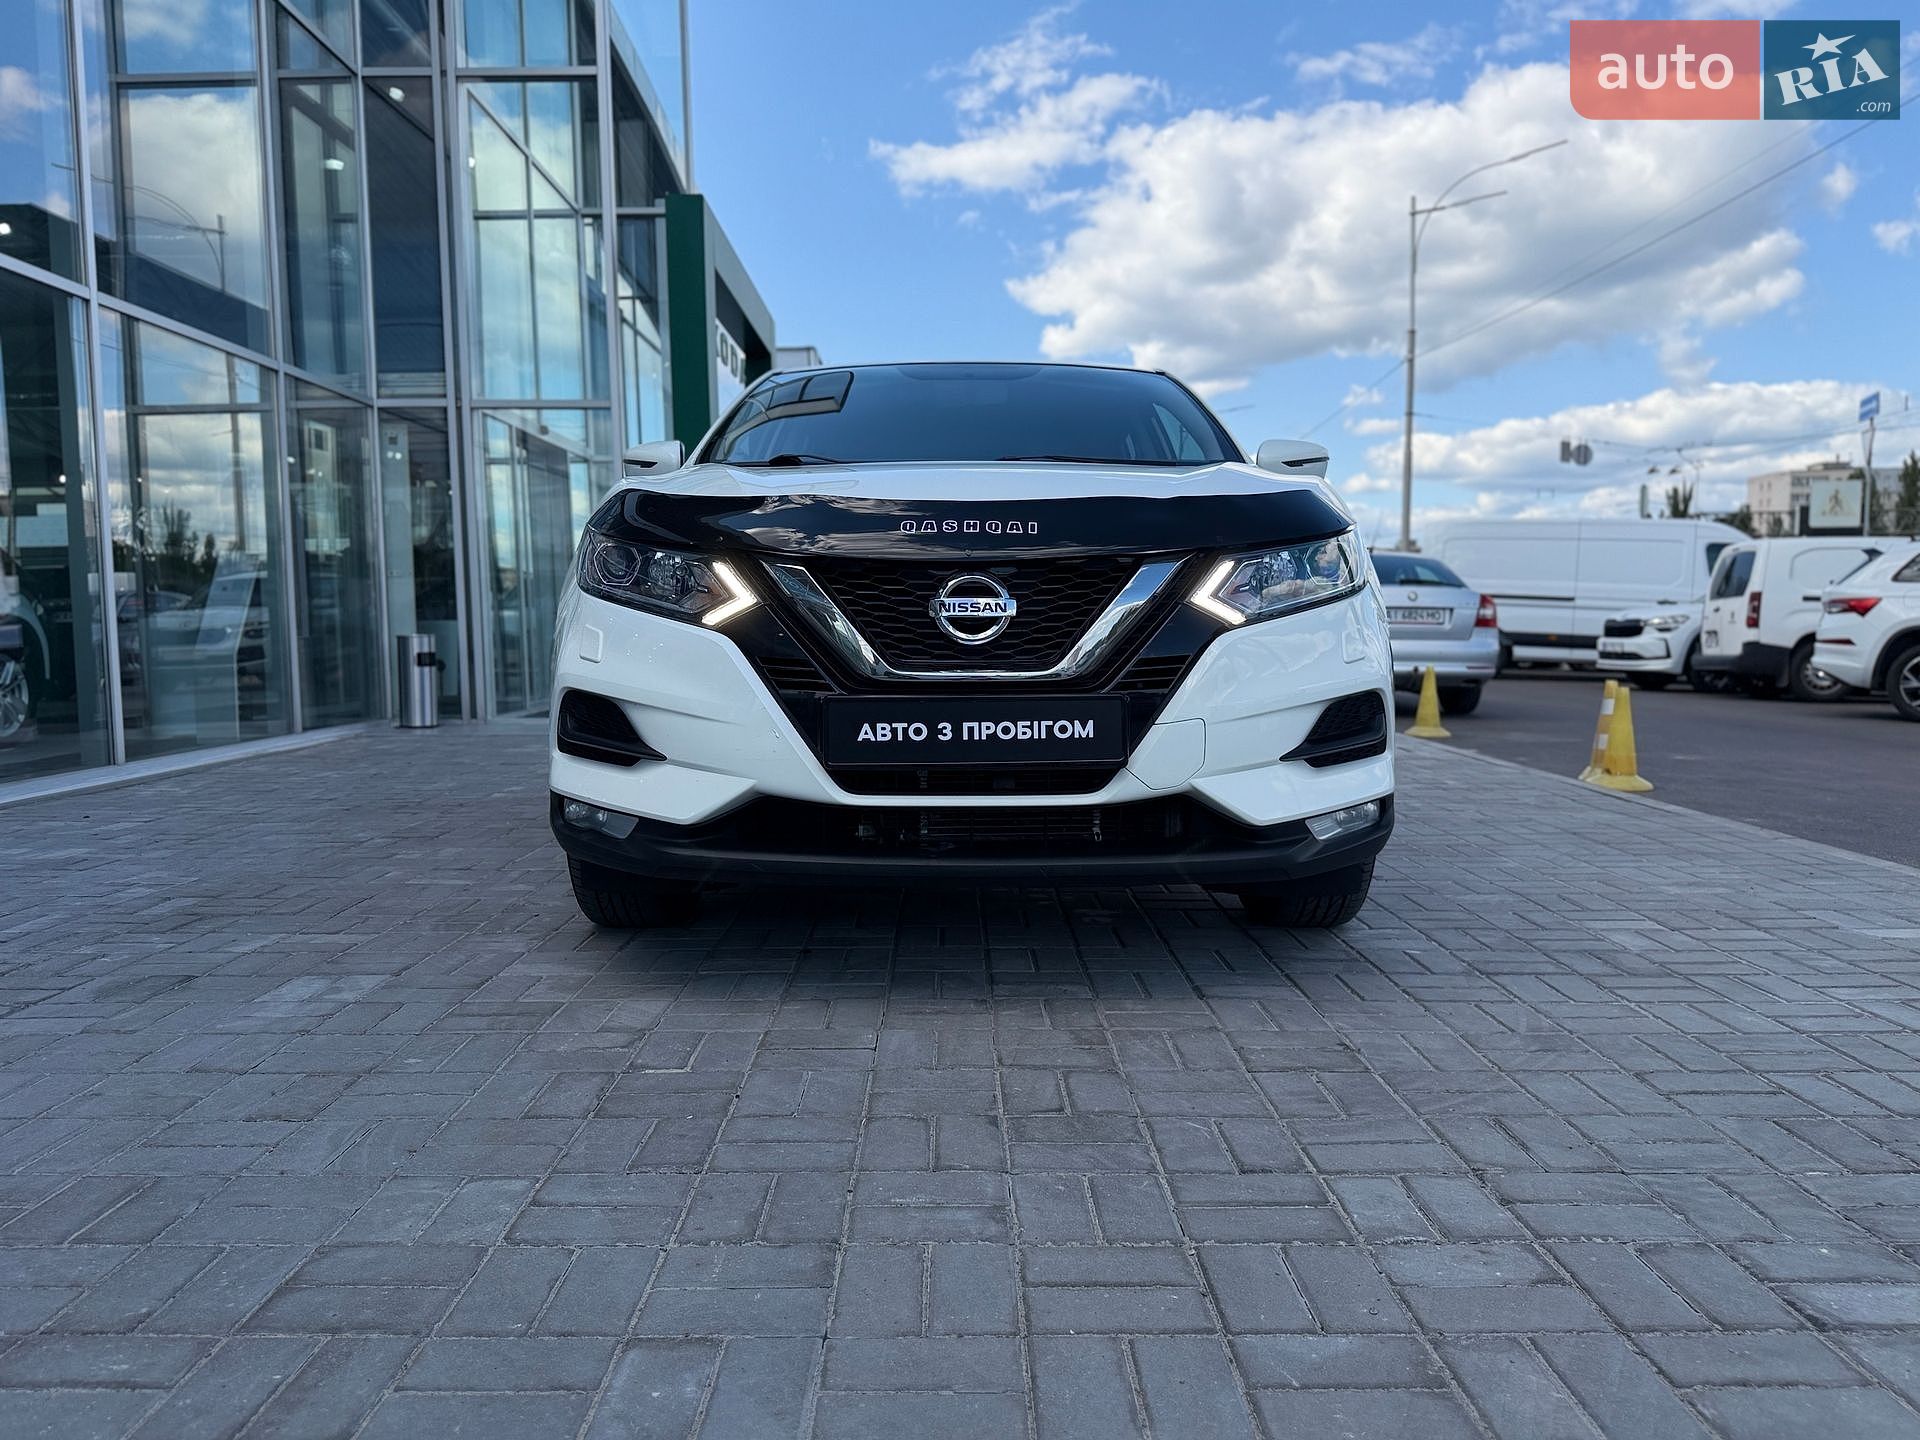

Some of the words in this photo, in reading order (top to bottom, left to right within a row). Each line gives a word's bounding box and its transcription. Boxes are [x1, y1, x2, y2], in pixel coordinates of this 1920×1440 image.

[900, 520, 1038, 535] QASHQAI
[938, 602, 1009, 613] NISSAN
[857, 722, 928, 742] АВТО
[962, 719, 1094, 741] ПРОБІГОМ
